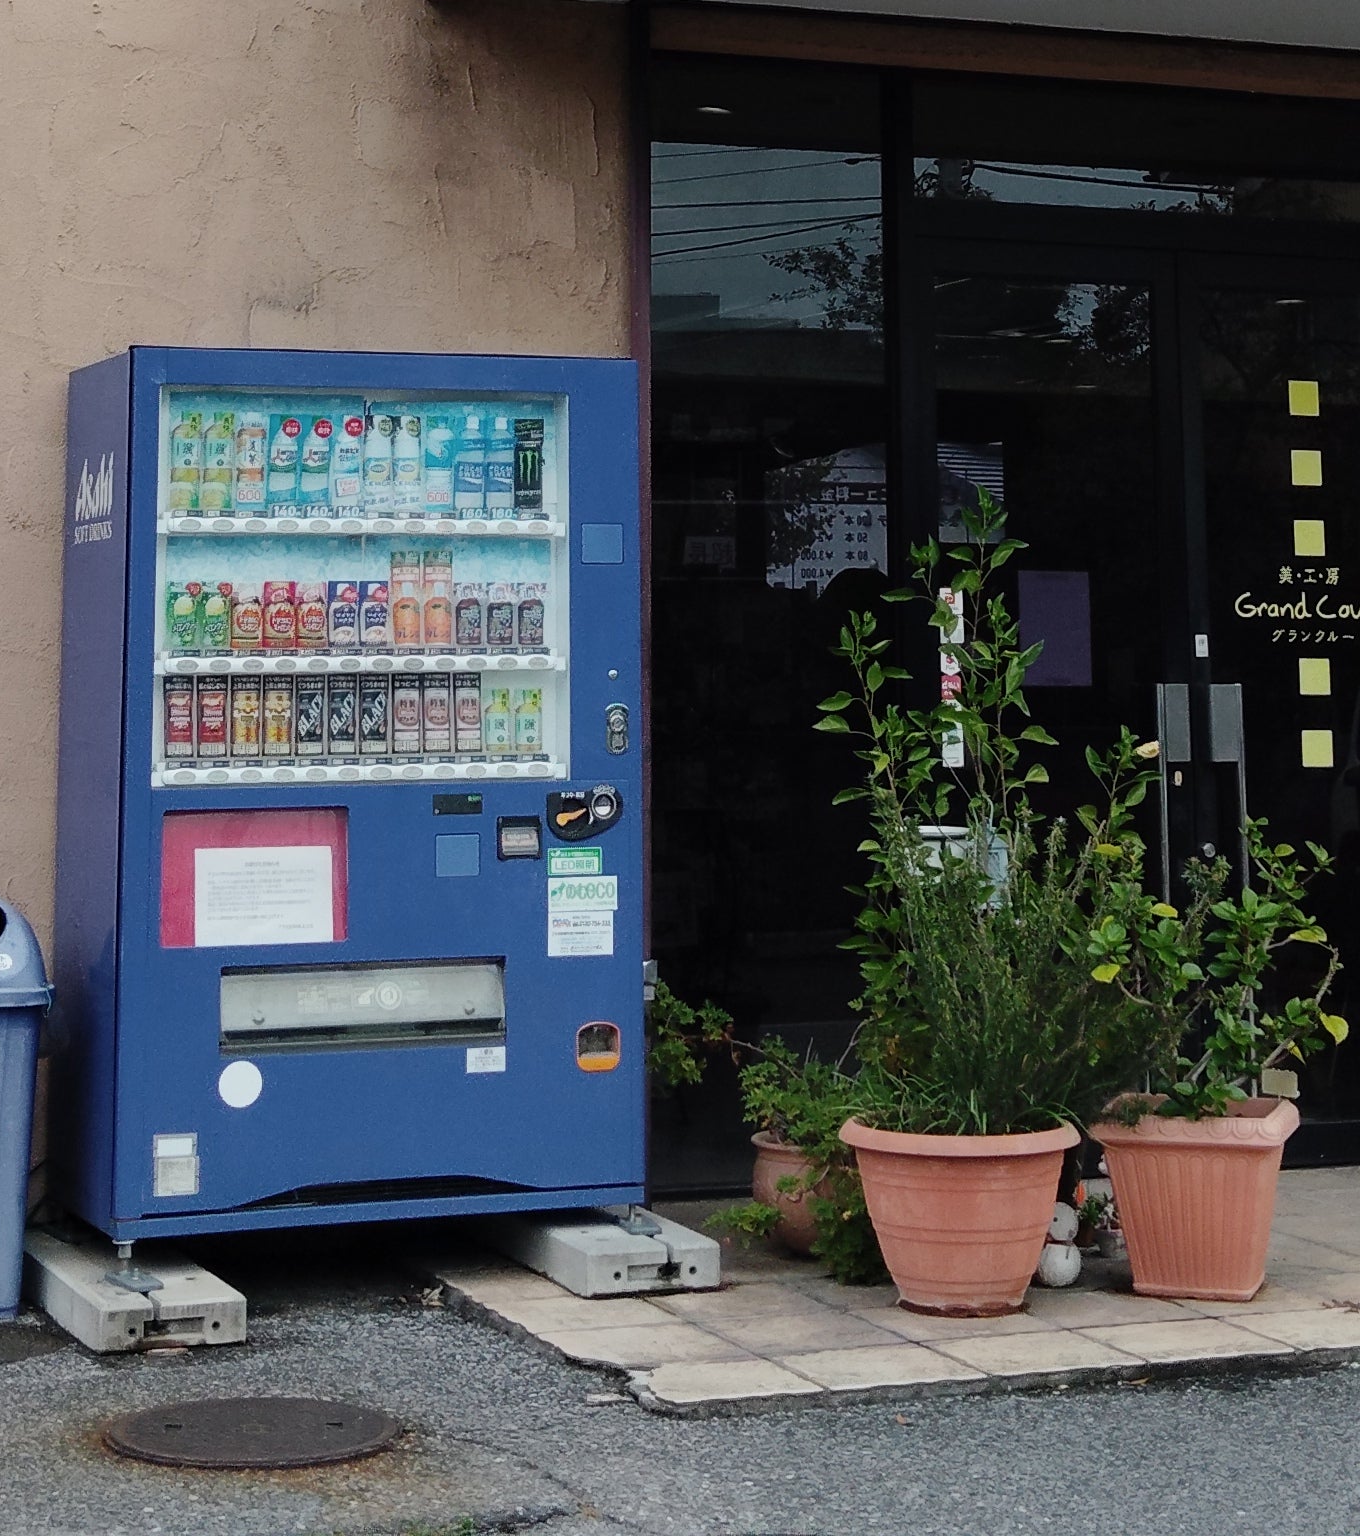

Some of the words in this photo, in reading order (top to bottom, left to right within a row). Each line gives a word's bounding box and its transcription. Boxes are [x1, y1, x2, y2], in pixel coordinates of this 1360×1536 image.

[74, 451, 114, 521] Asahi
[237, 490, 261, 501] 600
[1234, 591, 1312, 621] Grand
[1271, 628, 1355, 644] グランクルー
[298, 693, 322, 736] BLACK
[330, 693, 354, 735] BLACK
[361, 693, 386, 734] BLACK
